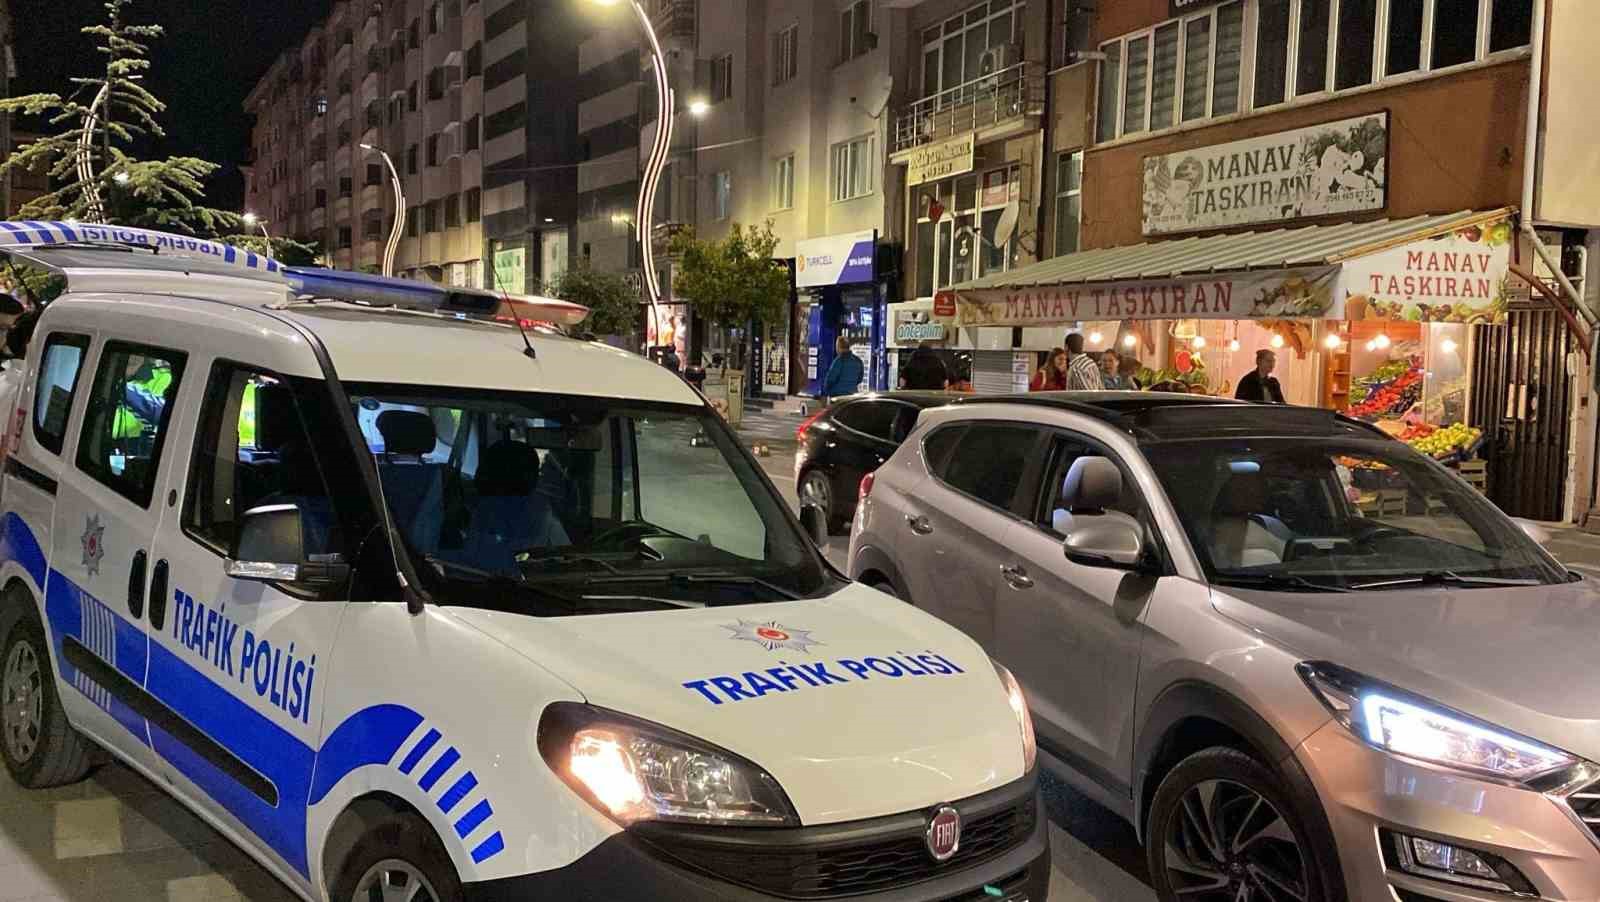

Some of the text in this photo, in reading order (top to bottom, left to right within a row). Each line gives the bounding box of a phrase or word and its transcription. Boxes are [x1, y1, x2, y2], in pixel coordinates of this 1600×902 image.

[1207, 144, 1295, 182] MANAV
[1406, 250, 1491, 273] MANAV
[1370, 274, 1491, 300] TAŞKIRAN
[1004, 291, 1081, 318] MANAV
[173, 588, 316, 724] TRAFİK POLİSİ
[682, 650, 965, 705] TRAFİK POLİSİ
[936, 822, 956, 848] FIAT
